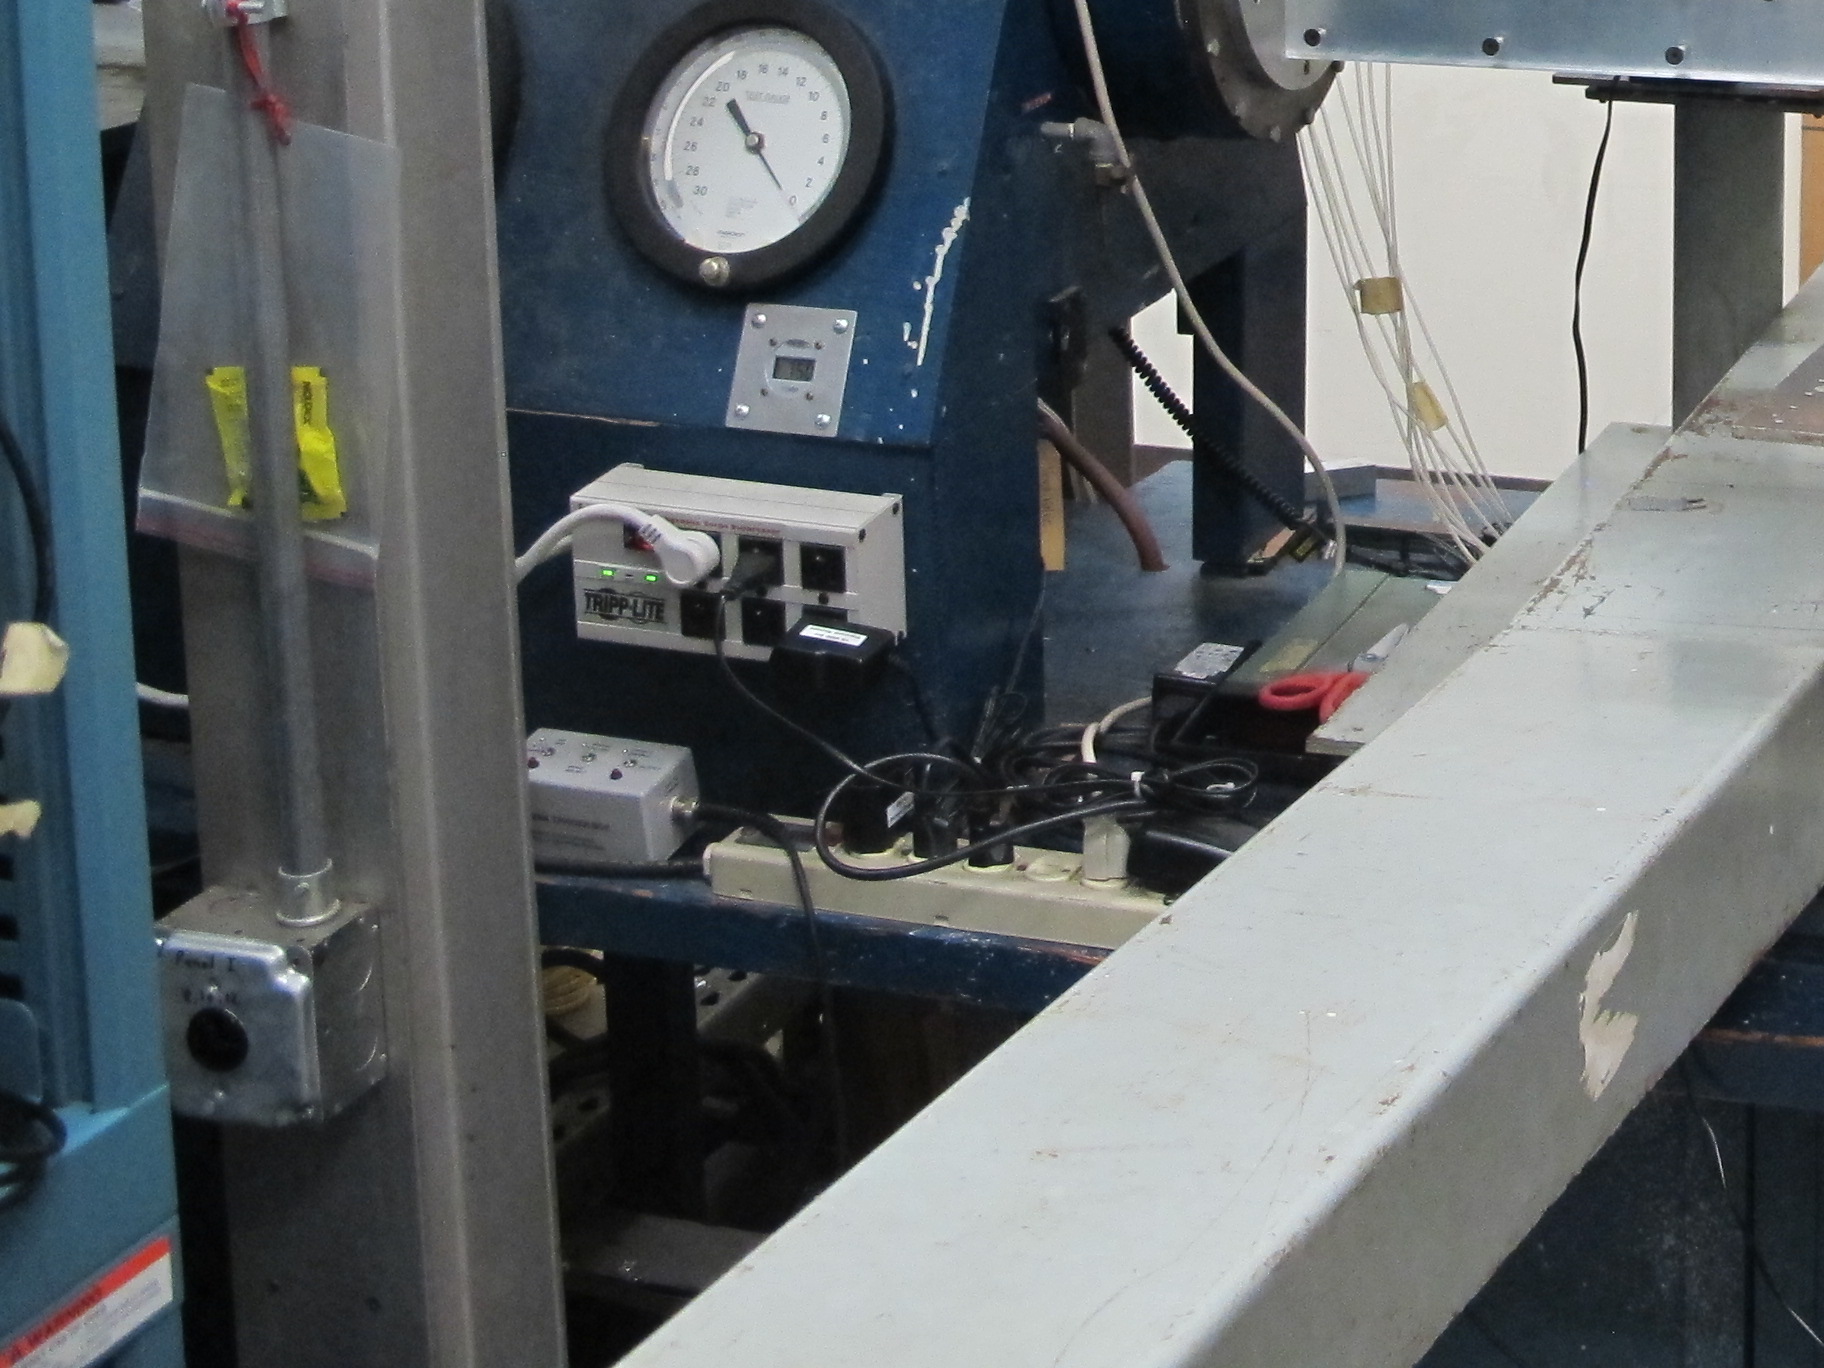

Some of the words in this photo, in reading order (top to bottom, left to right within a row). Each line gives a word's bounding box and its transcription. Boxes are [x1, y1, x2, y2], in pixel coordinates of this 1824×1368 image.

[736, 70, 748, 81] 18
[777, 67, 789, 76] 14
[715, 81, 730, 92] 20
[796, 77, 806, 87] 12
[702, 96, 717, 107] 22
[809, 91, 819, 102] 10
[820, 111, 827, 120] 8
[689, 117, 704, 127] 24
[822, 134, 830, 144] 6
[684, 141, 698, 152] 26
[817, 156, 825, 166] 4
[685, 166, 699, 177] 28
[805, 177, 813, 188] 2
[693, 185, 708, 196] 30
[789, 195, 797, 206] 0
